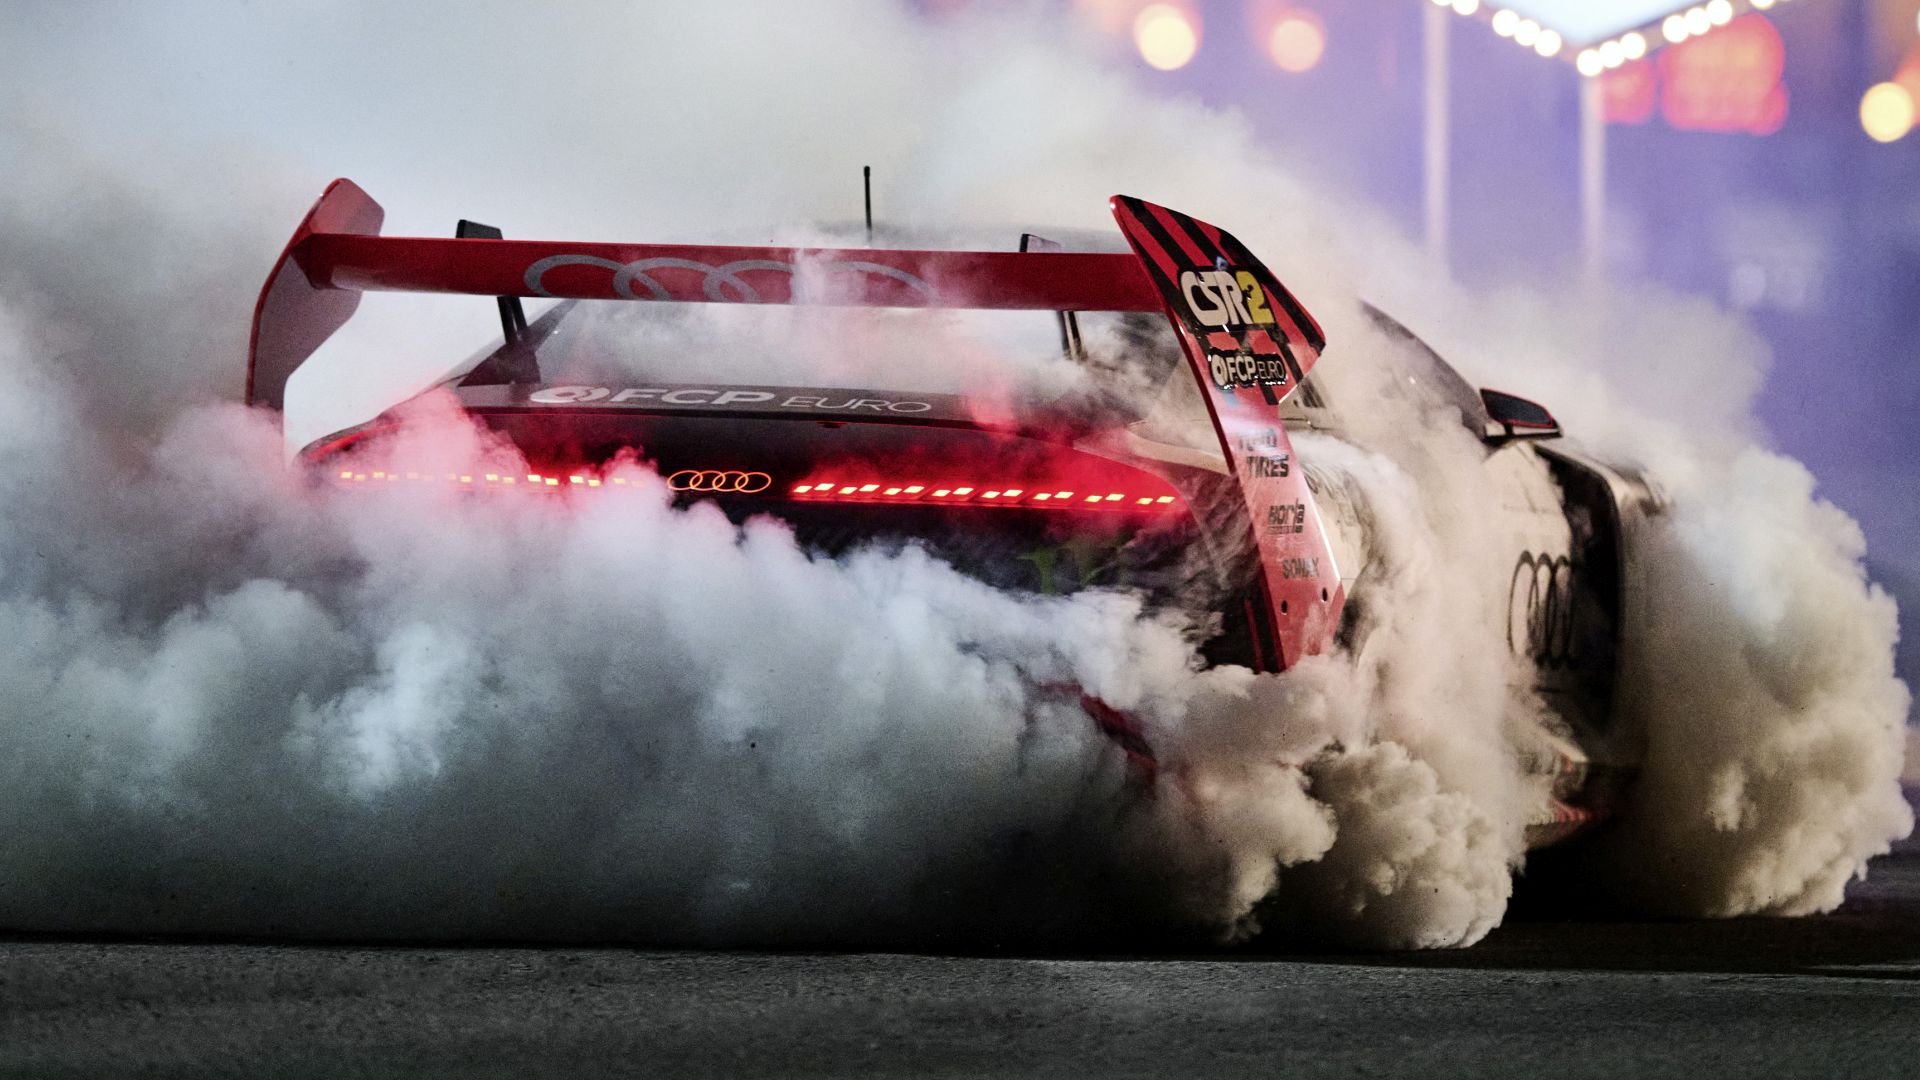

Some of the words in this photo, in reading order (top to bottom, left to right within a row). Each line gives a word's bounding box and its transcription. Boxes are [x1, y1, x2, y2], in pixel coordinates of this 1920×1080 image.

[1181, 270, 1275, 326] CSR2
[1227, 356, 1256, 382] FCP
[1257, 360, 1285, 380] EURO
[610, 387, 776, 405] FCP
[780, 395, 932, 413] EURO
[1246, 454, 1289, 478] TIRES
